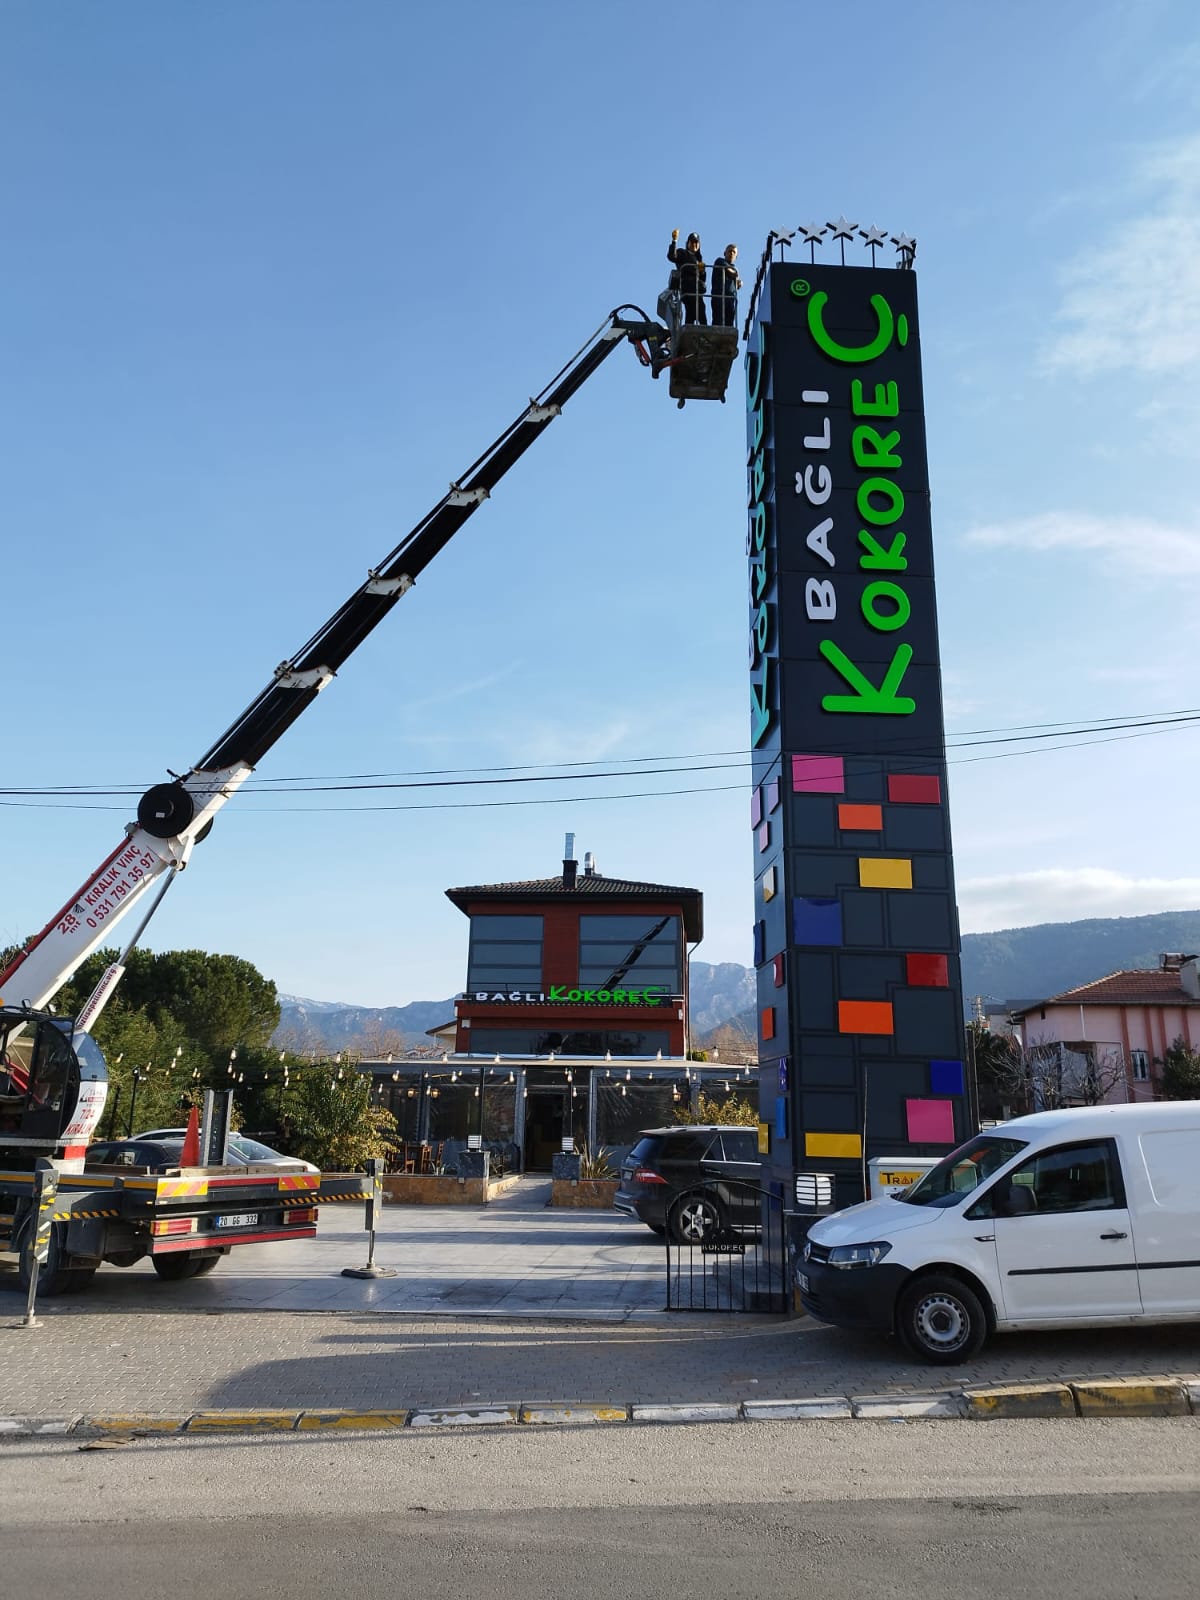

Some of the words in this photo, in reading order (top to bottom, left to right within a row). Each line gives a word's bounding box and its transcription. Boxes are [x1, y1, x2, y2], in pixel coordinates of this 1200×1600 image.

[796, 390, 837, 621] BAĞLI
[808, 291, 916, 715] KOKOREÇ
[86, 917, 97, 928] 0
[94, 898, 114, 920] 531
[110, 879, 131, 901] 791
[127, 865, 144, 882] 35
[139, 852, 155, 869] 97
[57, 914, 77, 935] 28
[476, 991, 544, 1002] BAĞLI
[220, 1216, 228, 1227] 20
[245, 1214, 257, 1225] 332
